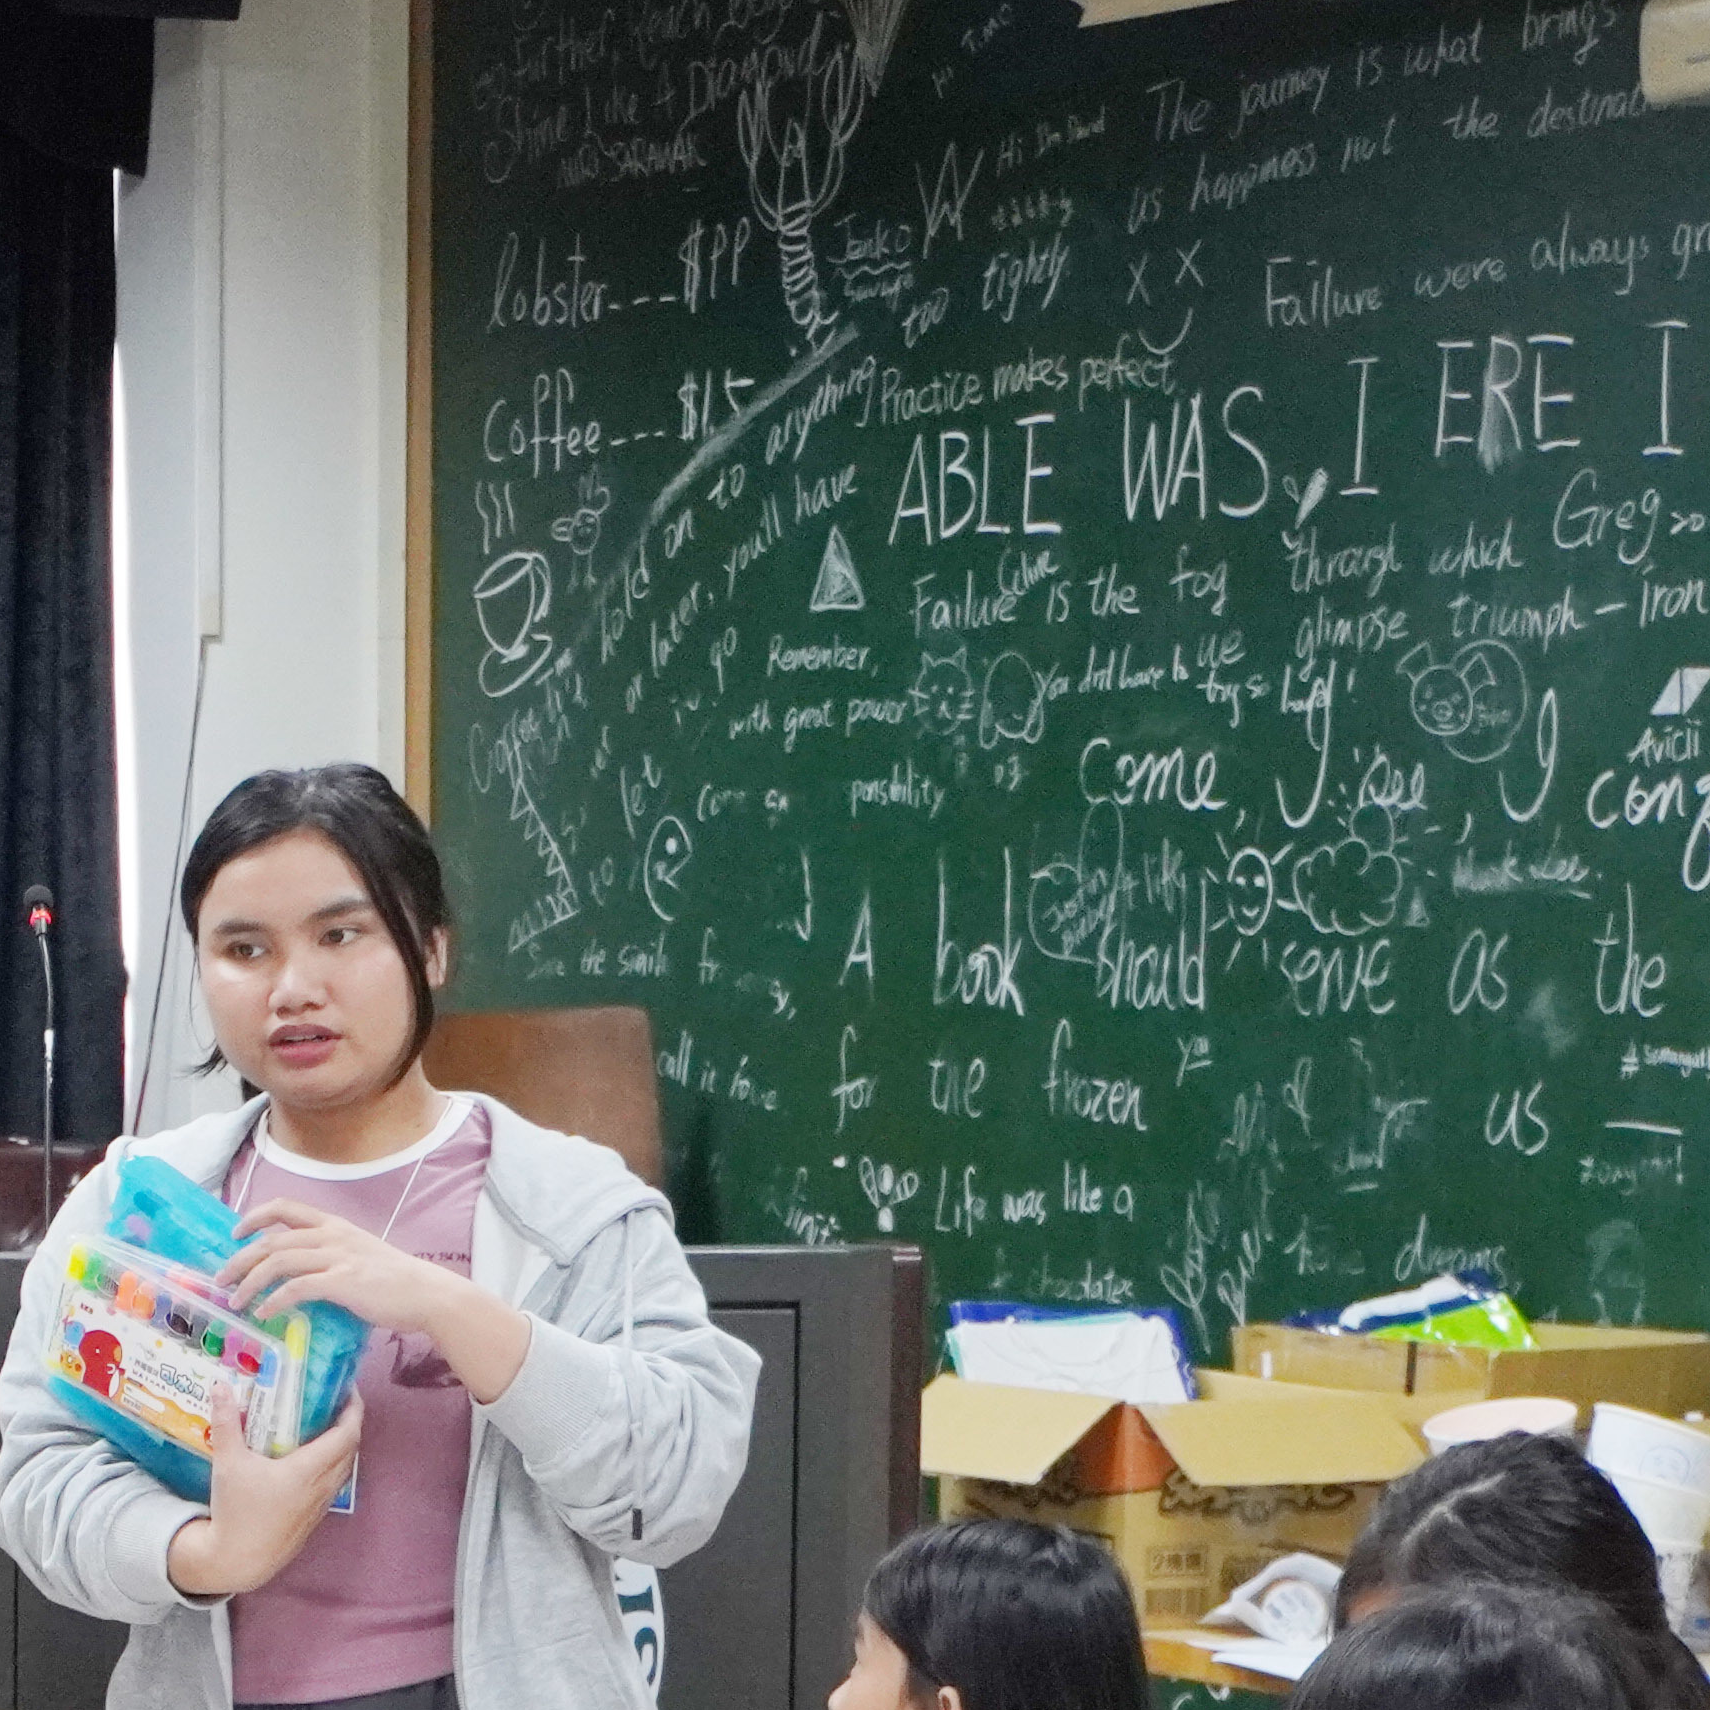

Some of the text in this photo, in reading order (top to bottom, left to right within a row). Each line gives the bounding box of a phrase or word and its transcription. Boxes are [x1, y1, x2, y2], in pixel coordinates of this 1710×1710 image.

[1146, 77, 1212, 142] The
[1264, 254, 1382, 328] Failure
[1414, 257, 1507, 298] were
[1079, 332, 1176, 413] perfect
[887, 315, 1691, 546] ABLE WAS I ERE I
[910, 567, 1018, 640] Failure
[1086, 563, 1142, 618] the
[833, 886, 875, 1000] A
[1591, 881, 1667, 1018] the
[1040, 1017, 1148, 1131] frozen
